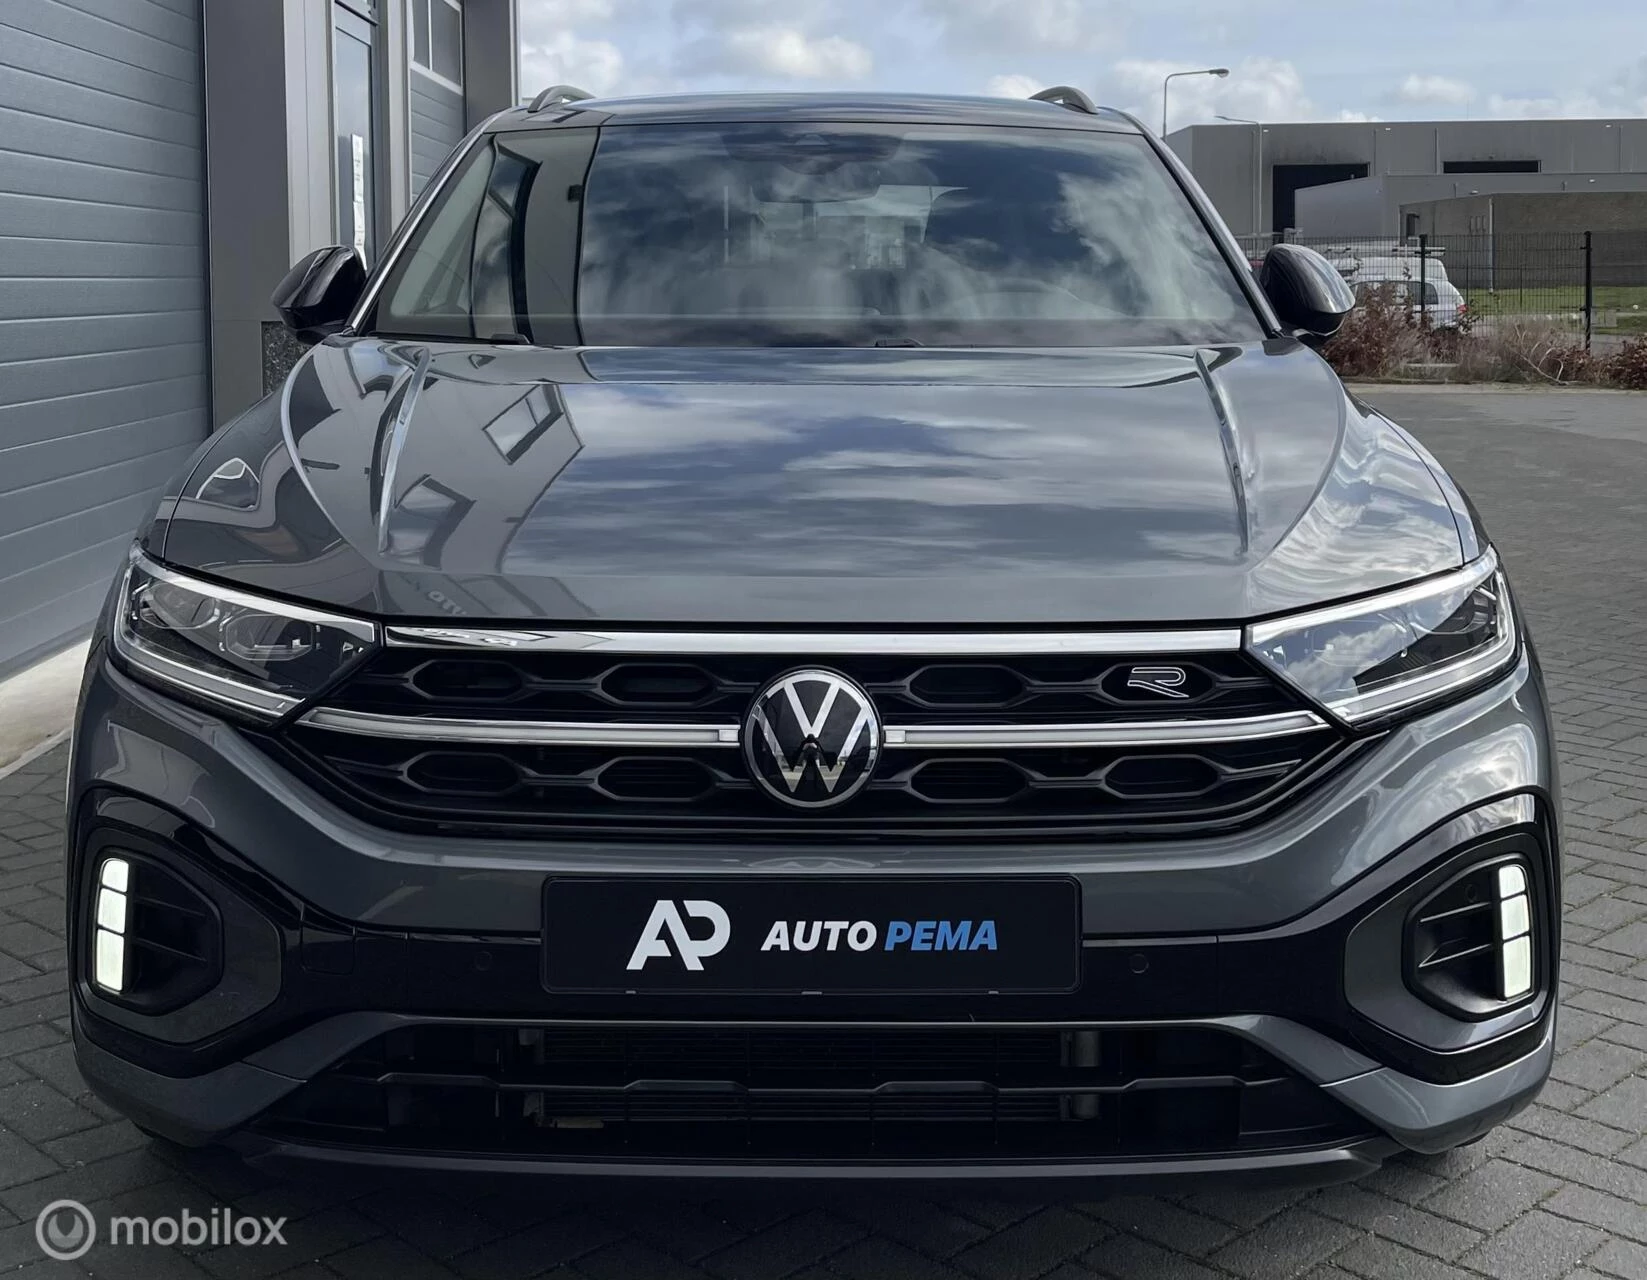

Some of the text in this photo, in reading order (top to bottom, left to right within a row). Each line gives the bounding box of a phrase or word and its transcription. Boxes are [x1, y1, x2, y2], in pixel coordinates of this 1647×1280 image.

[744, 669, 880, 807] VW
[626, 900, 731, 971] AP
[760, 920, 998, 952] AUTO PEMA
